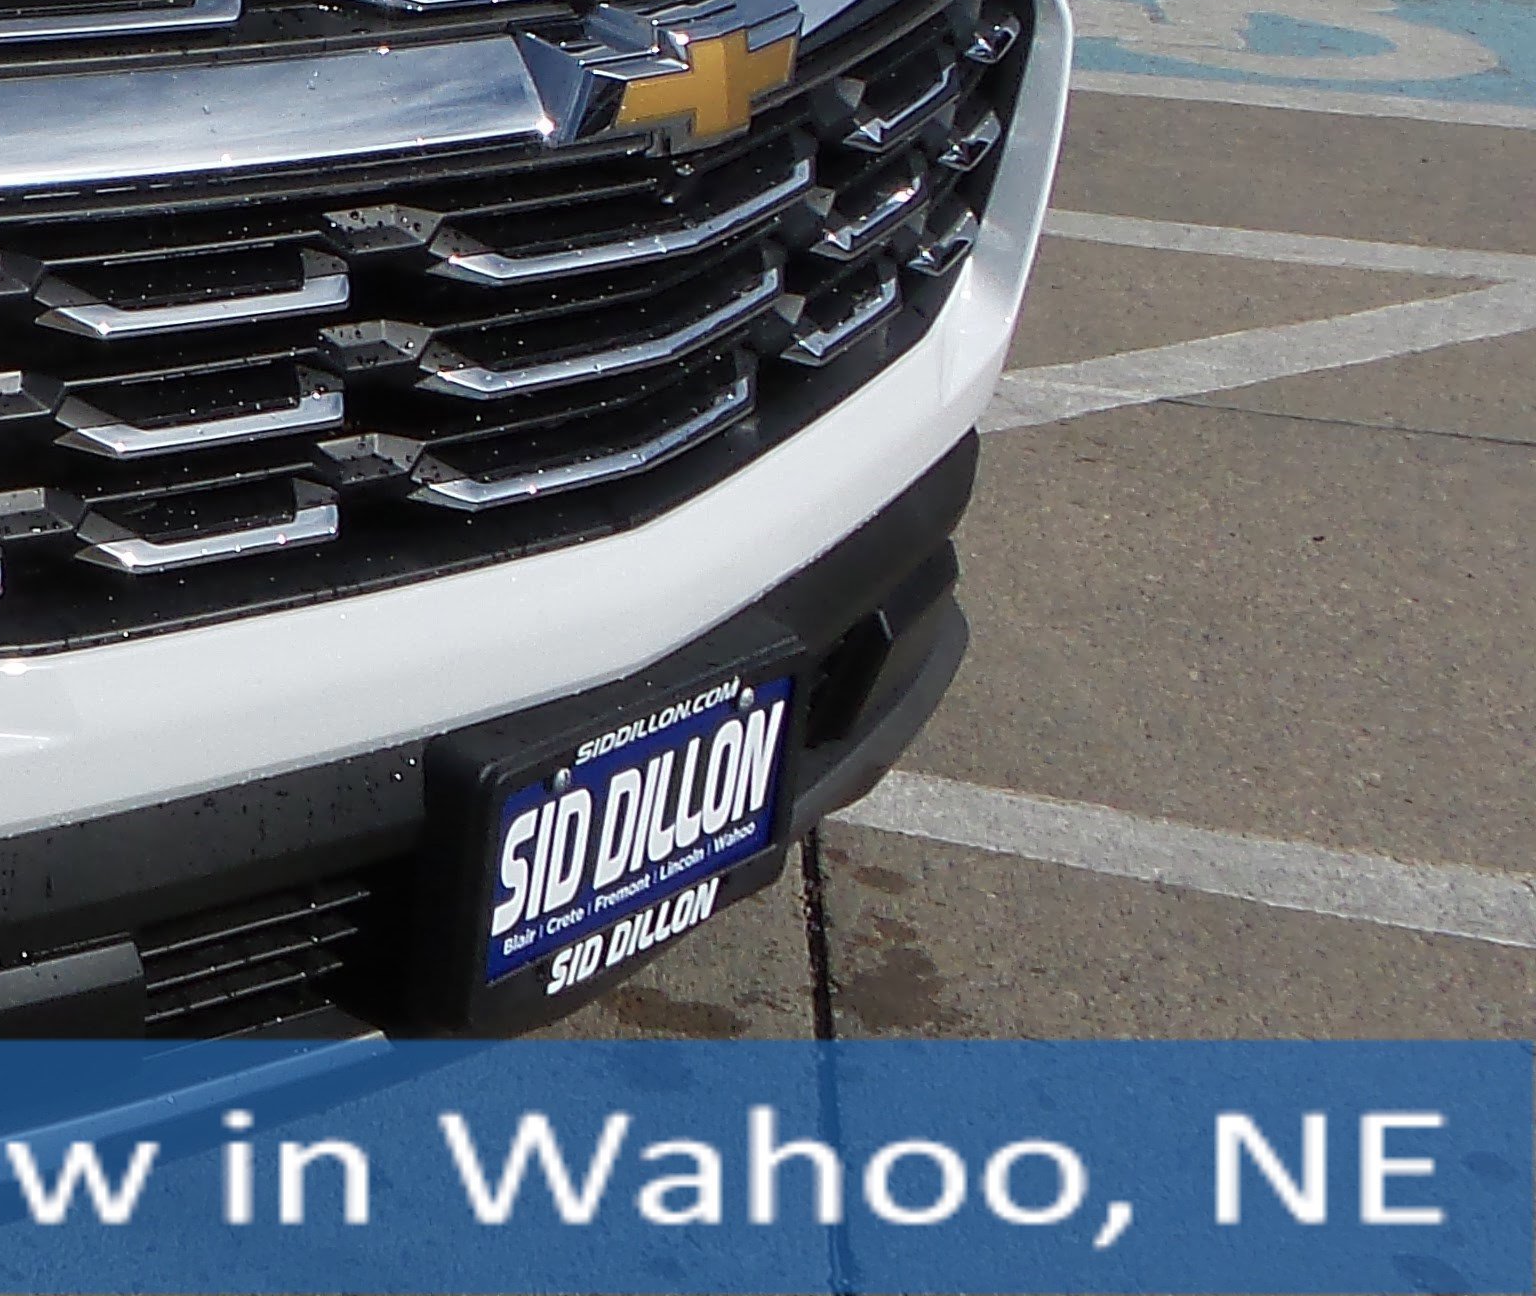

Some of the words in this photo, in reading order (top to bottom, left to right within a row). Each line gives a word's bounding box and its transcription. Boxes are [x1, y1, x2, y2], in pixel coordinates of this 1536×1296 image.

[575, 675, 741, 766] SIDDILLON.COM
[491, 788, 593, 937] SID
[593, 700, 786, 891] DILLON
[503, 928, 537, 956] Blair
[546, 907, 585, 935] Crete
[594, 874, 651, 913] Fremont
[659, 847, 705, 880] Lincoln
[713, 821, 756, 854] Wahoo
[546, 934, 603, 996] SID
[606, 877, 720, 968] DILLON
